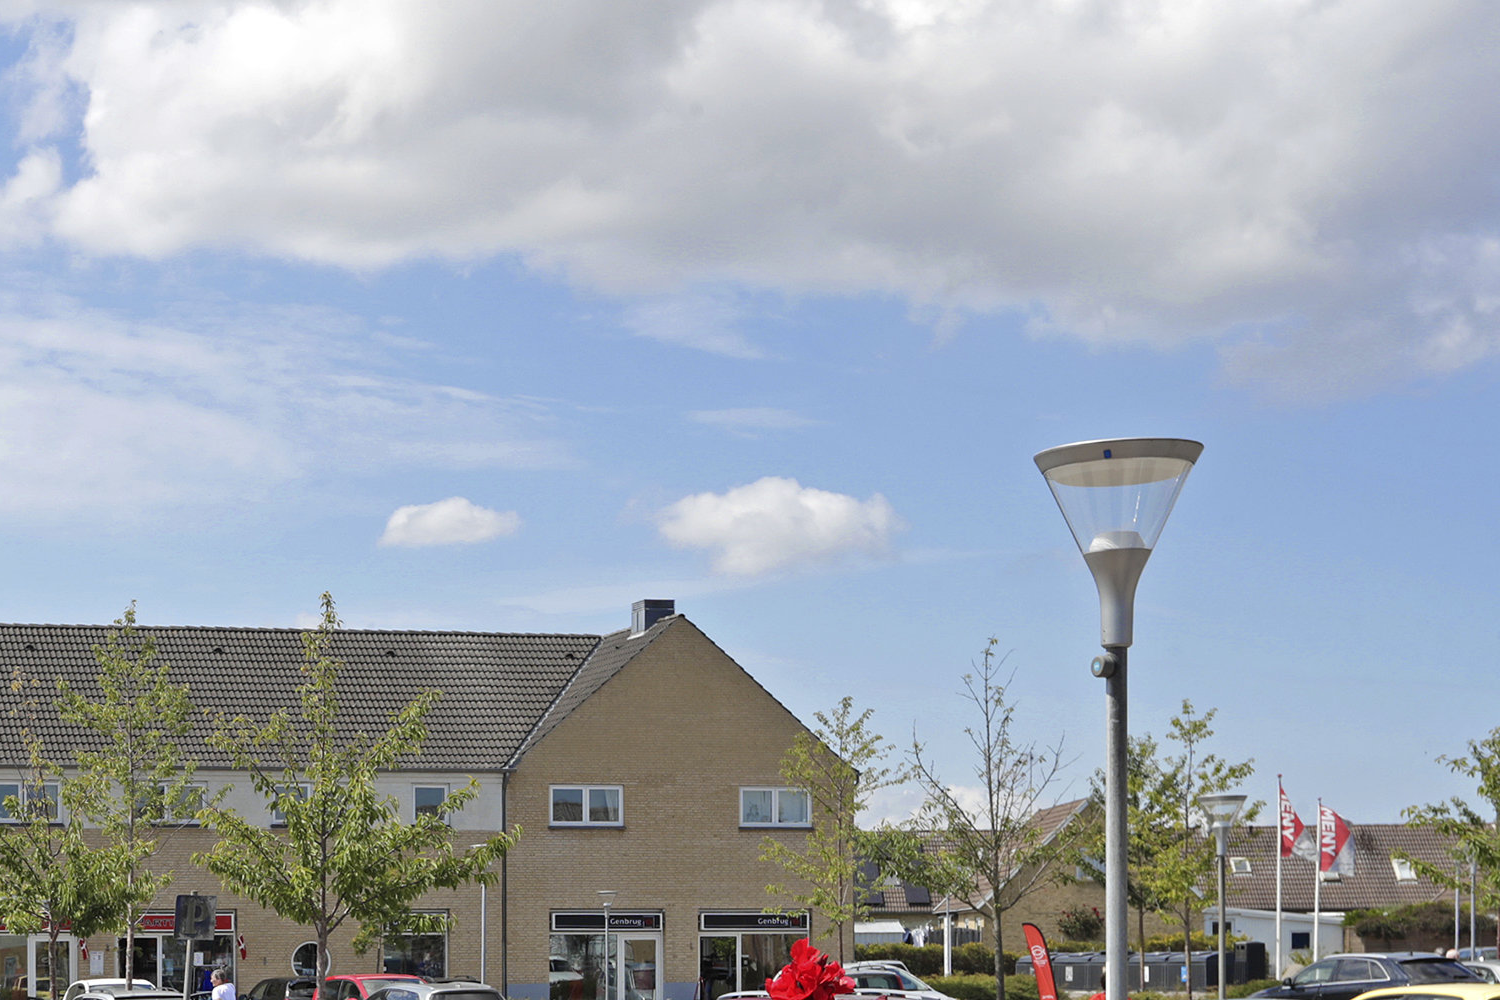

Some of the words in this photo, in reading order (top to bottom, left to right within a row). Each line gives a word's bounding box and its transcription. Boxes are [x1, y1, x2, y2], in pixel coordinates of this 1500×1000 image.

[1320, 806, 1336, 857] MENY
[610, 918, 642, 926] Genbrug
[757, 918, 789, 926] Genbrug
